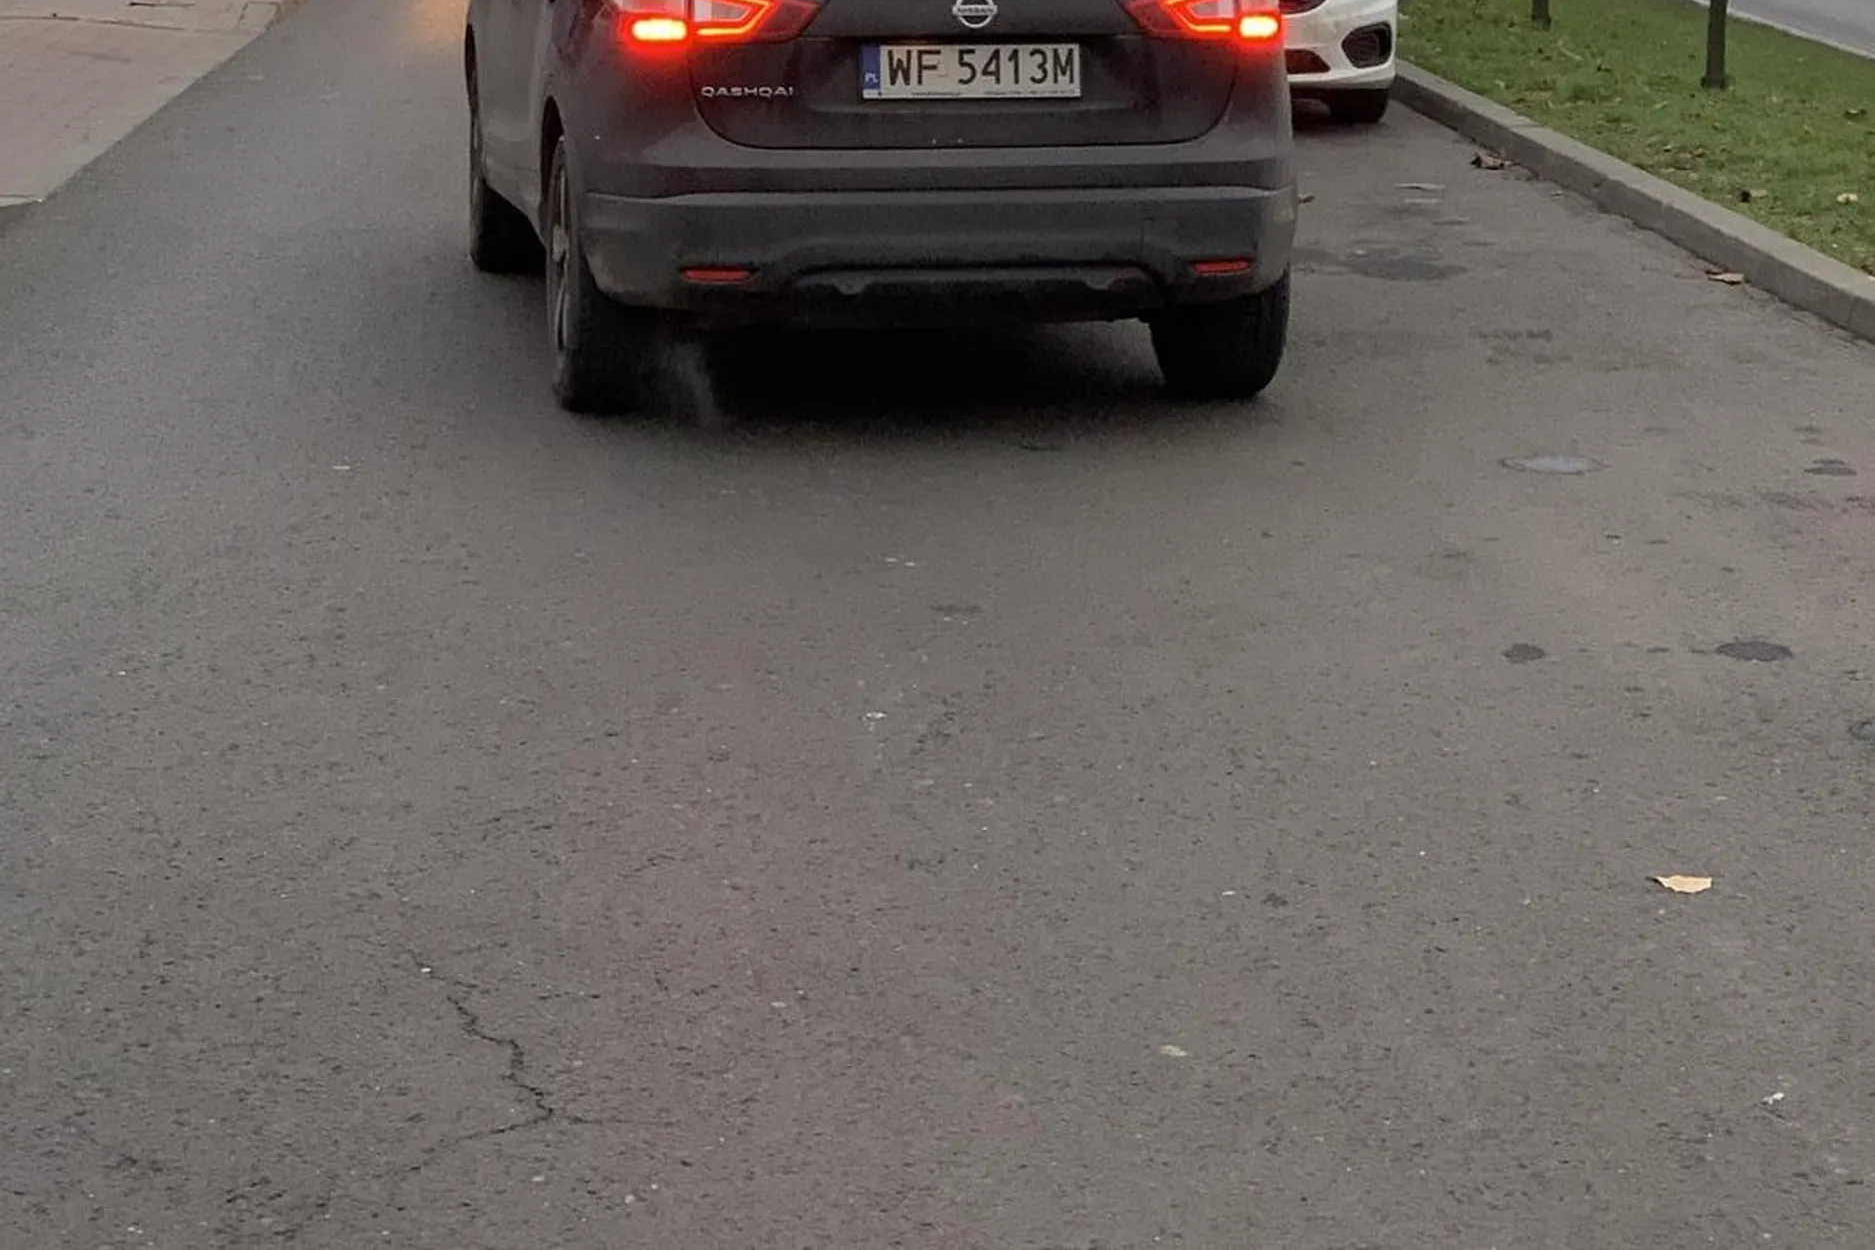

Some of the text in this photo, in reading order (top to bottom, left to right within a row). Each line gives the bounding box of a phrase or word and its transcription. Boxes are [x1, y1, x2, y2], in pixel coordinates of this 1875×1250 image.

[887, 48, 1075, 86] WF 5413M
[700, 86, 795, 98] QASHQAI
